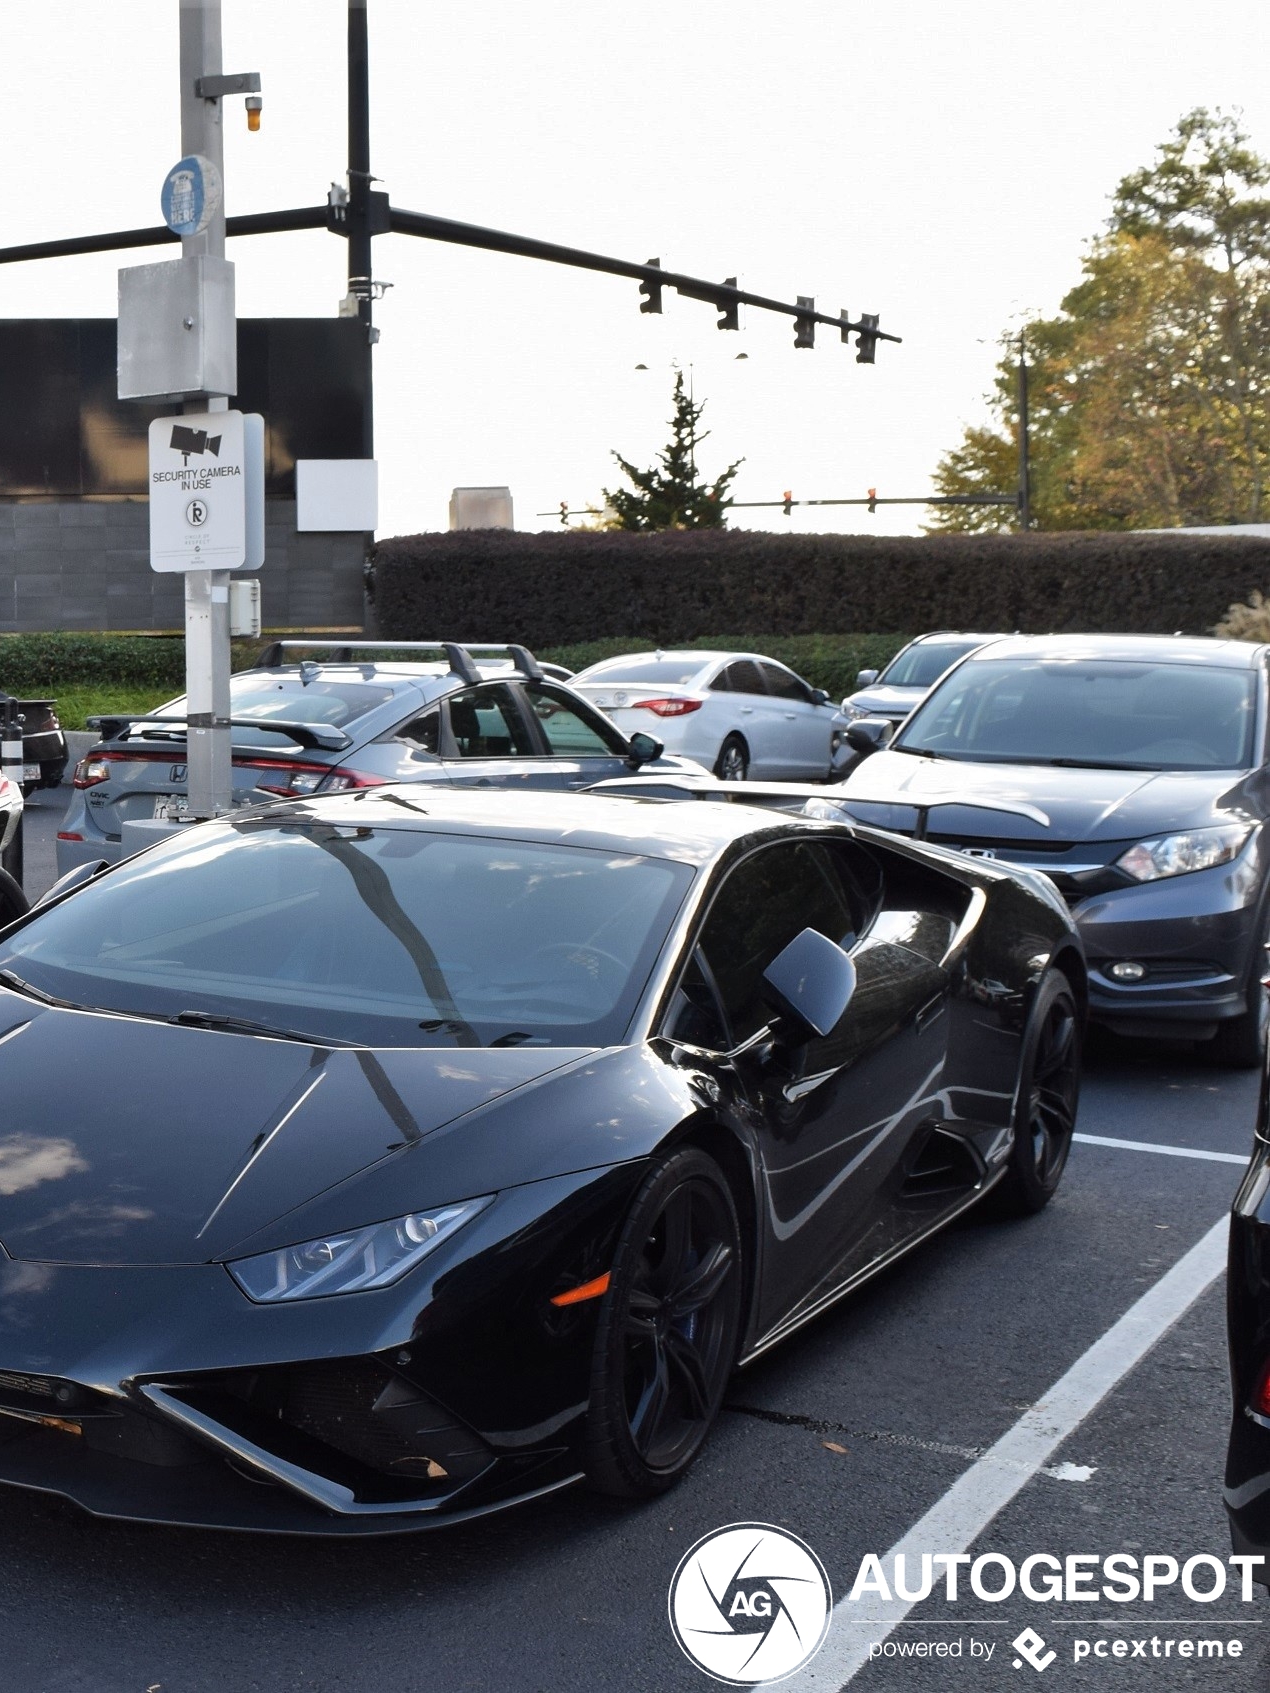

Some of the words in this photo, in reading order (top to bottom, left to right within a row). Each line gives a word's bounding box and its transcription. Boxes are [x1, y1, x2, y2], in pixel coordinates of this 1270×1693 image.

[153, 469, 198, 483] SECURITY
[199, 466, 241, 479] CAMERA
[181, 482, 191, 491] IN
[192, 479, 212, 490] USE
